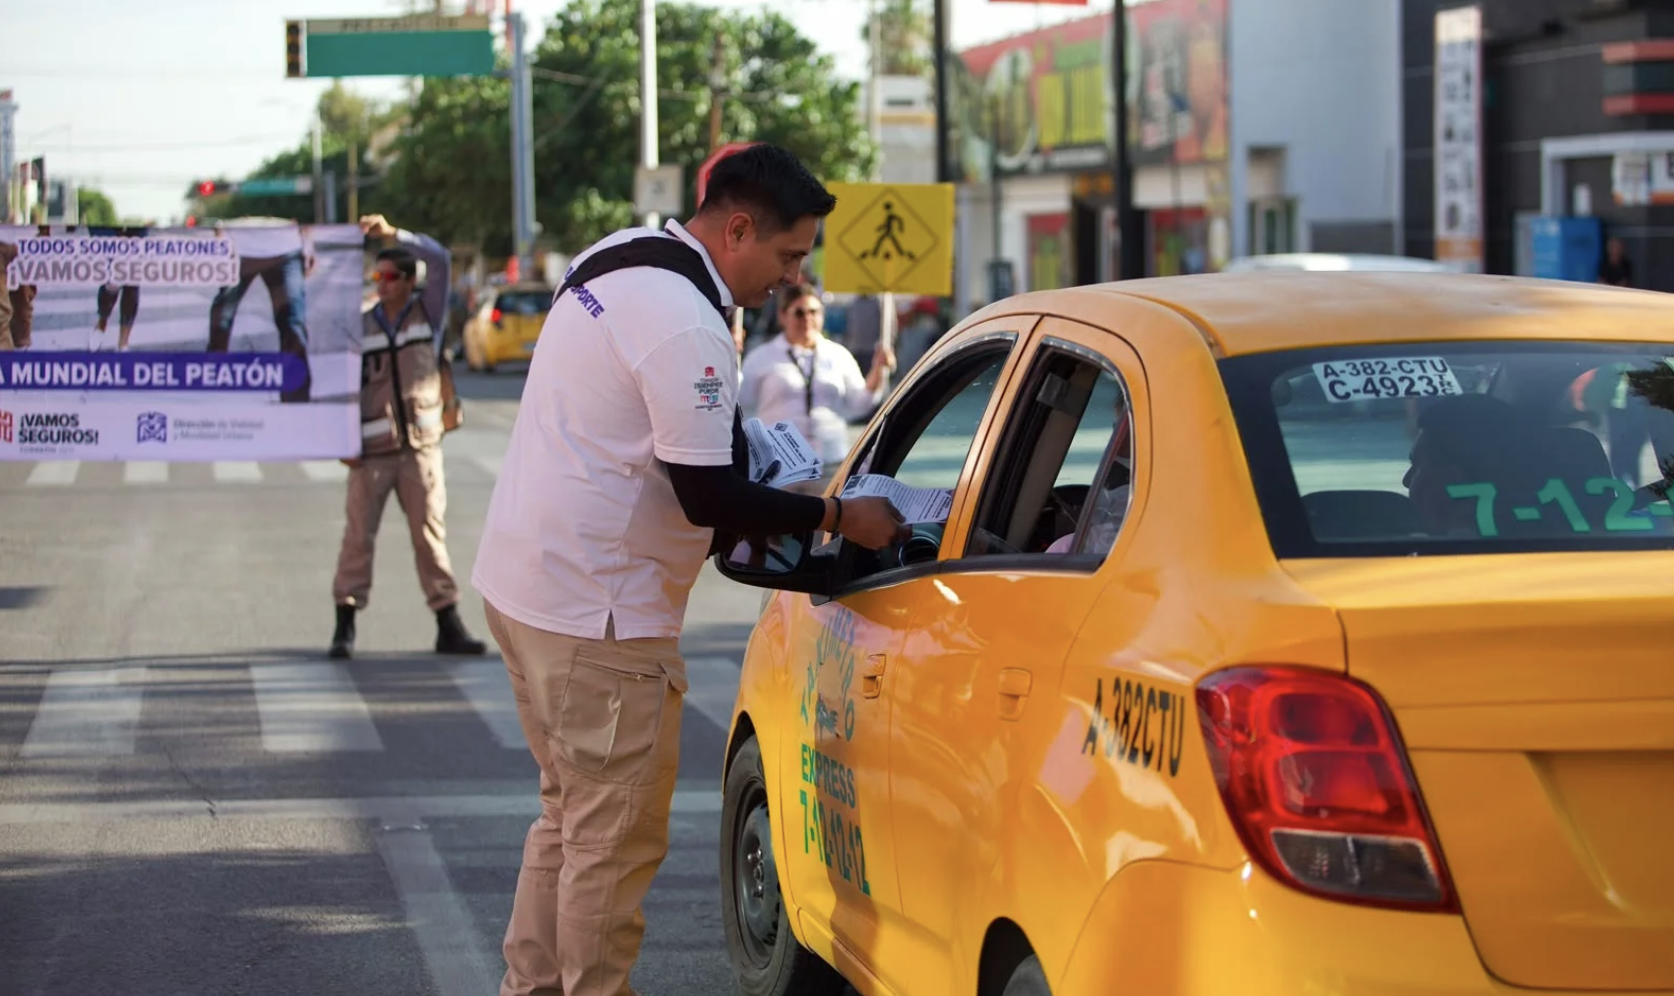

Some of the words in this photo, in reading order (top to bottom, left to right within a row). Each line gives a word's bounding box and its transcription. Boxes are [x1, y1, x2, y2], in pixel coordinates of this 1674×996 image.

[19, 239, 75, 254] TODOS
[80, 239, 139, 254] SOMOS
[145, 239, 229, 255] PEATONES
[10, 261, 107, 286] ¡VAMOS
[114, 261, 236, 283] SEGUROS!
[11, 361, 128, 386] MUNDIAL
[133, 362, 179, 387] DEL
[185, 357, 284, 388] PEATÓN
[1323, 359, 1448, 379] A-382-CTU
[1328, 374, 1439, 400] C-4923
[20, 414, 80, 428] ¡VAMOS
[19, 429, 99, 445] SEGUROS!
[802, 743, 856, 809] EXPRESS
[800, 789, 871, 897] 7-12-12-12
